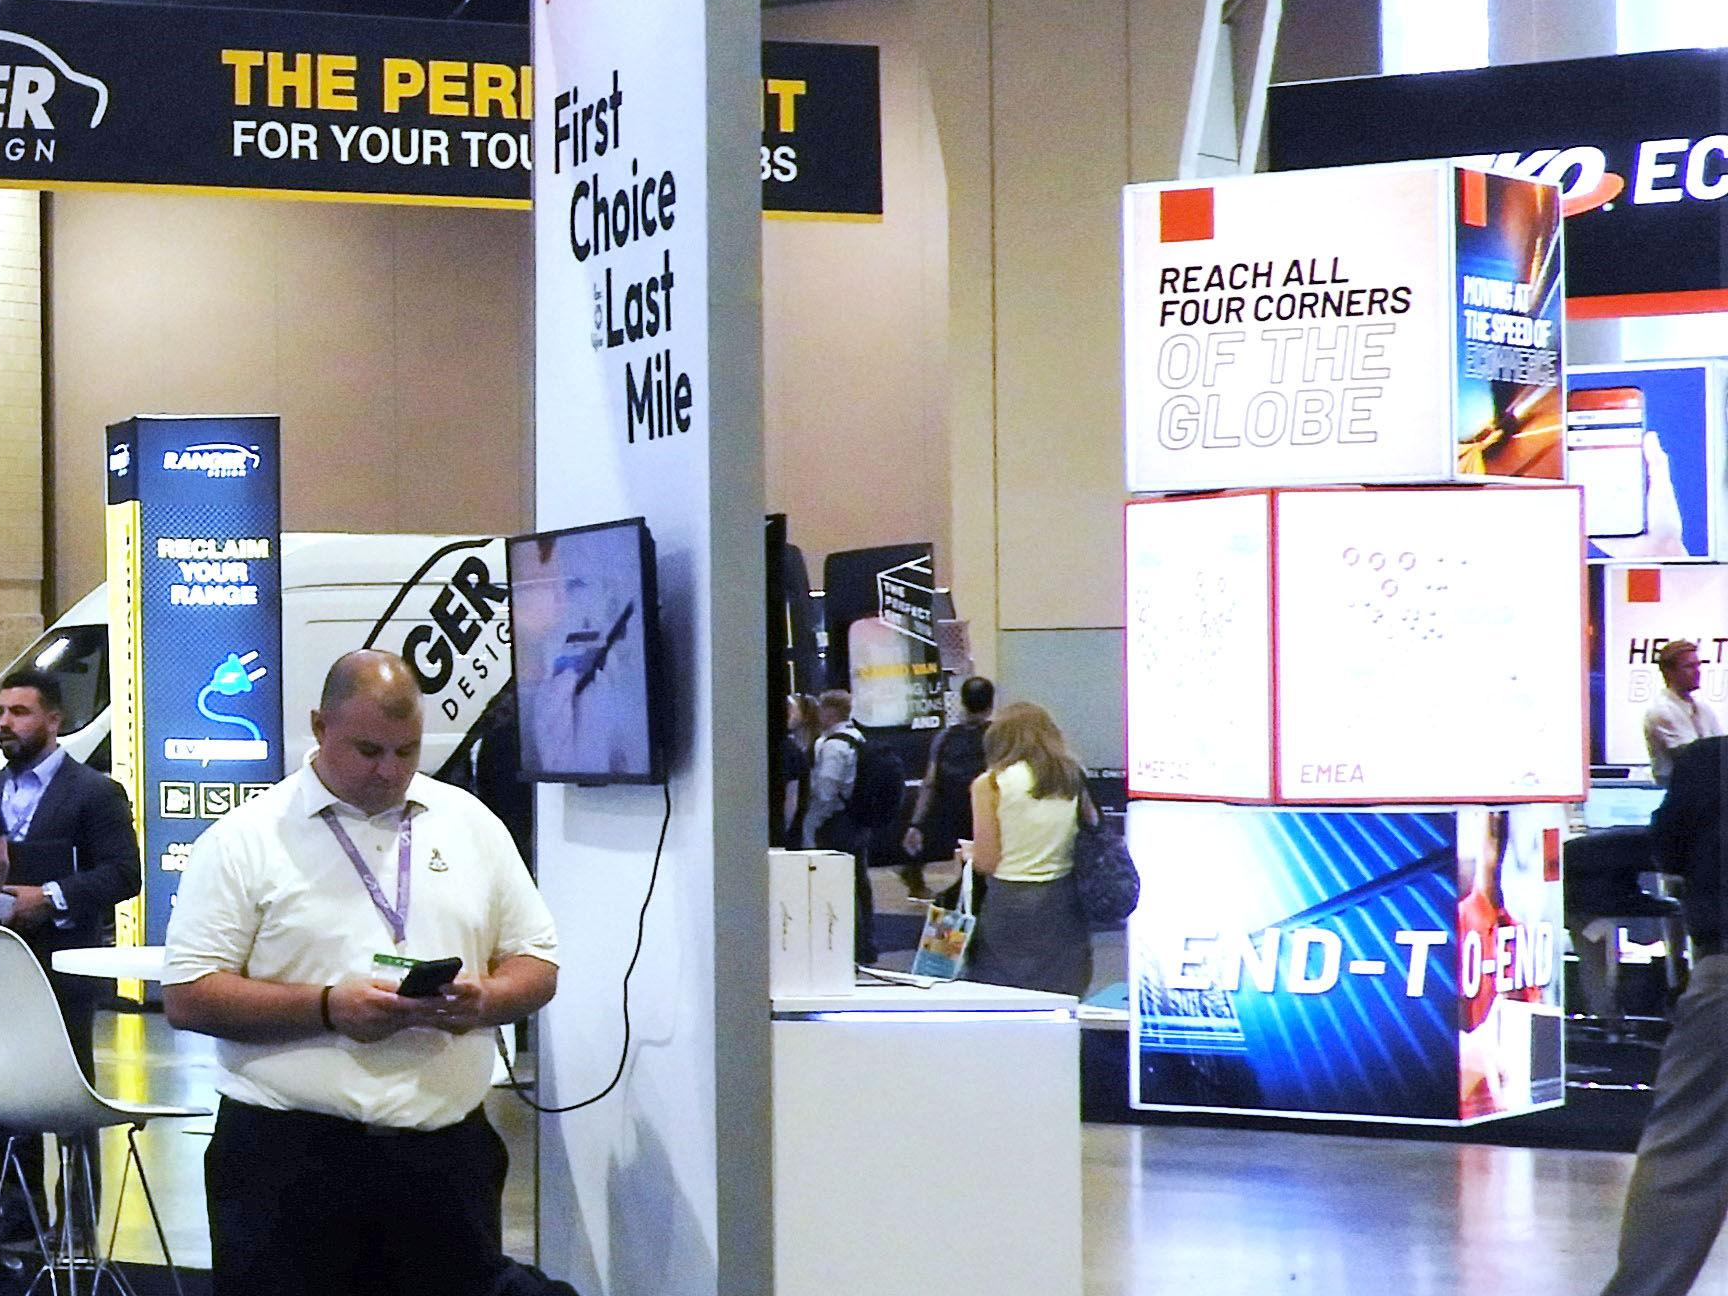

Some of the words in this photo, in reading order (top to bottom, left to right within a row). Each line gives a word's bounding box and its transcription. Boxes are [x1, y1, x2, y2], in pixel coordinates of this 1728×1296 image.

[221, 48, 358, 112] THE
[383, 57, 533, 122] PER
[232, 120, 319, 158] FOR
[329, 123, 450, 167] YOUR
[461, 129, 533, 172] TOU
[554, 69, 624, 174] First
[570, 158, 677, 263] Choice
[605, 249, 675, 349] Last
[1158, 260, 1274, 295] REACH
[1282, 256, 1350, 288] ALL
[1159, 296, 1246, 327] FOUR
[1253, 286, 1412, 322] CORNERS
[1156, 330, 1246, 390] OF
[1260, 322, 1396, 385] THE
[626, 349, 693, 444] Mile
[1156, 386, 1383, 451] GLOBE
[156, 537, 271, 560] RECLAIM
[177, 561, 249, 583] YOUR
[170, 584, 259, 606] RANGE
[401, 556, 511, 696] GER
[441, 621, 512, 722] DESIG
[1299, 763, 1365, 784] EMEA
